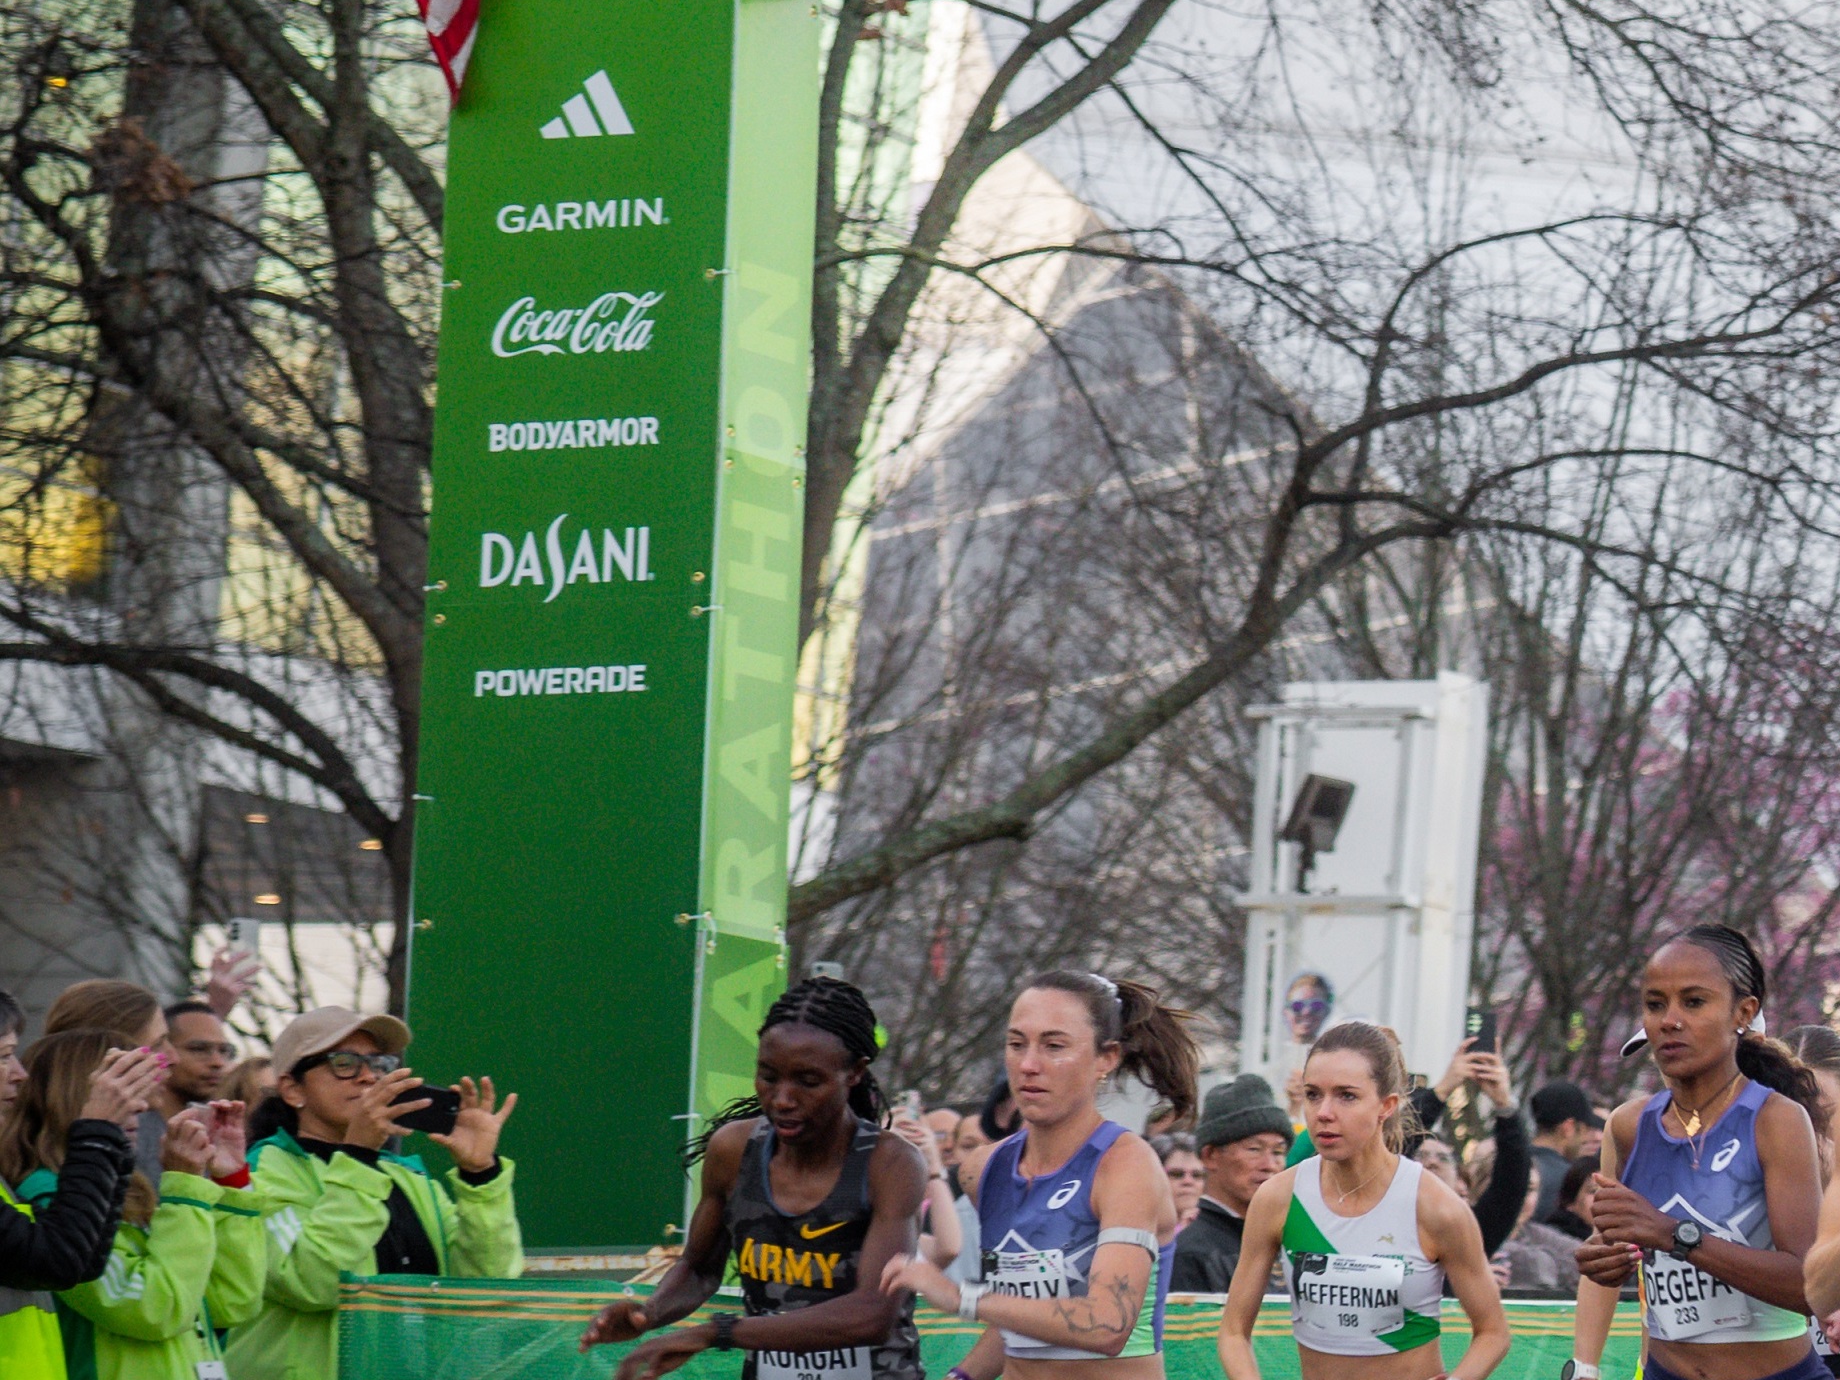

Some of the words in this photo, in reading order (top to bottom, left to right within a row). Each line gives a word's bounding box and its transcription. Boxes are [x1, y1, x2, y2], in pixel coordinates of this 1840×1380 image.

[496, 197, 665, 235] GARMIN
[490, 291, 667, 358] Coca-Cola
[488, 415, 659, 453] BODYARMOR
[479, 513, 651, 604] DASANI
[473, 664, 648, 698] POWERADE
[739, 1237, 842, 1290] ARMY
[1298, 1282, 1400, 1308] HEFFERNAN
[1644, 1268, 1733, 1306] DEGEFA
[1337, 1313, 1359, 1328] 198
[1675, 1306, 1700, 1325] 233
